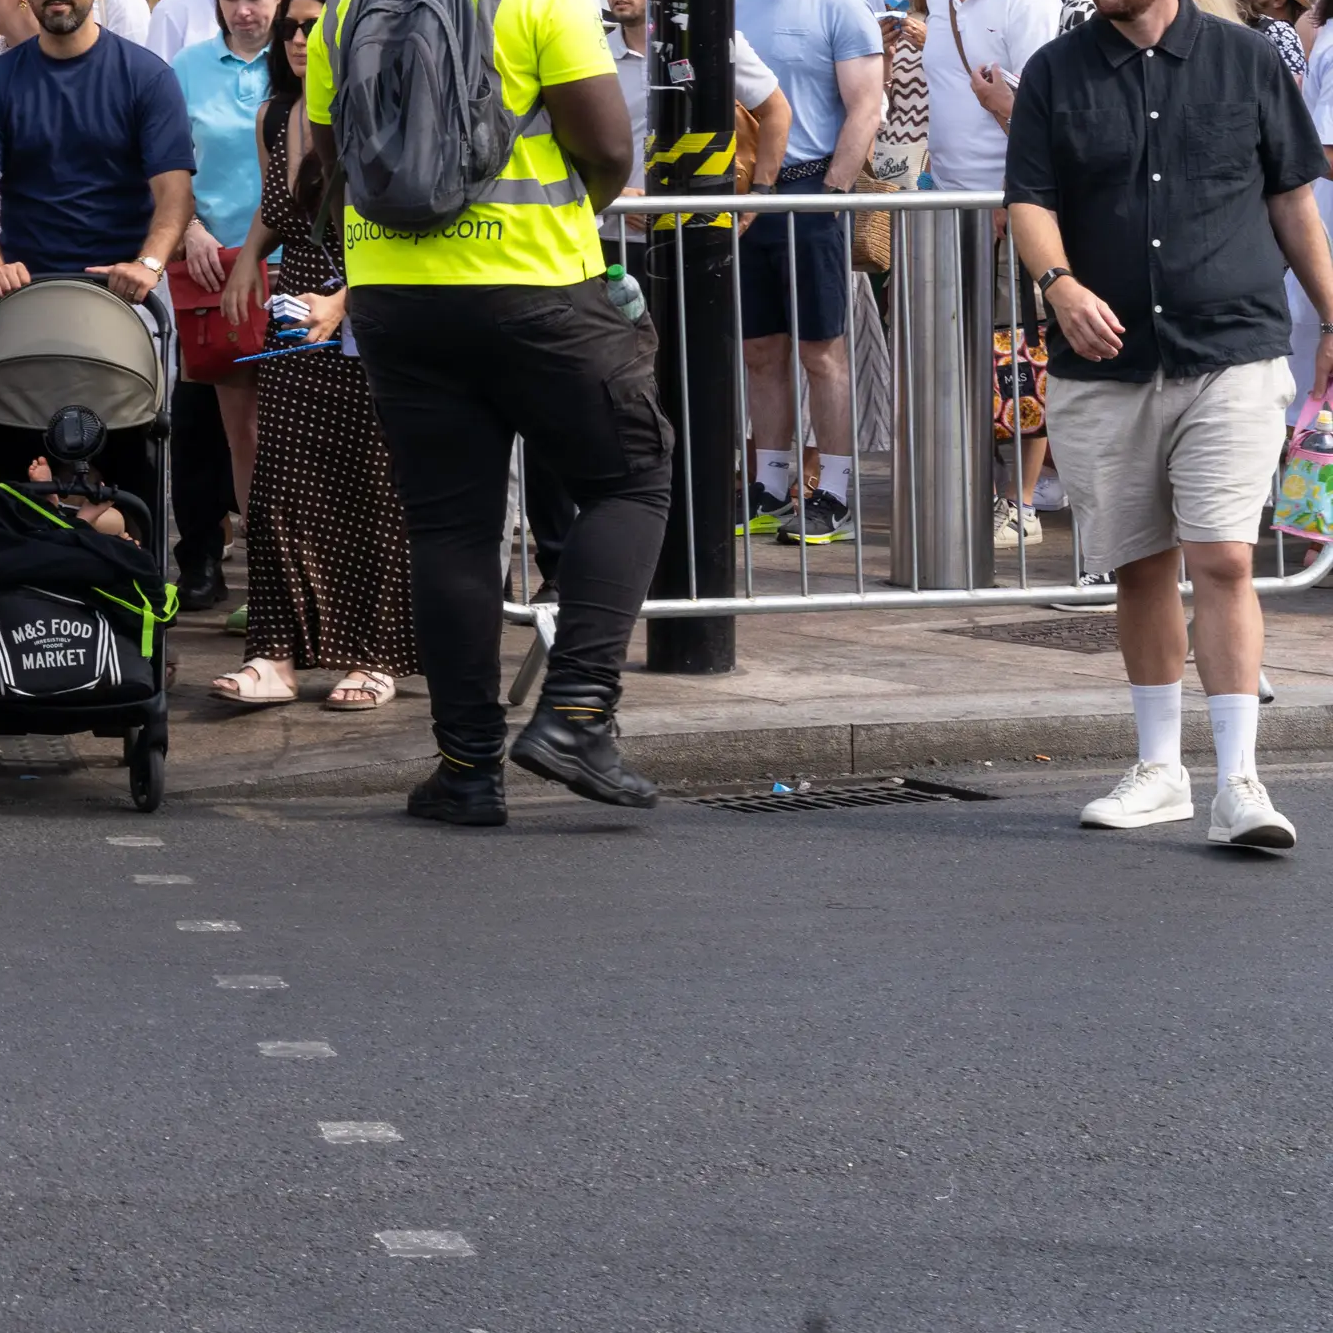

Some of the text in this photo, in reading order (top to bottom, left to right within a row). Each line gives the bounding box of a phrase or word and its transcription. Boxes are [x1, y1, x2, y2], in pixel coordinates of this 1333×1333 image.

[1004, 373, 1028, 385] MS
[11, 619, 93, 645] M&S FOOD
[34, 637, 71, 646] IRRESISTIBLY
[21, 649, 86, 670] MARKET
